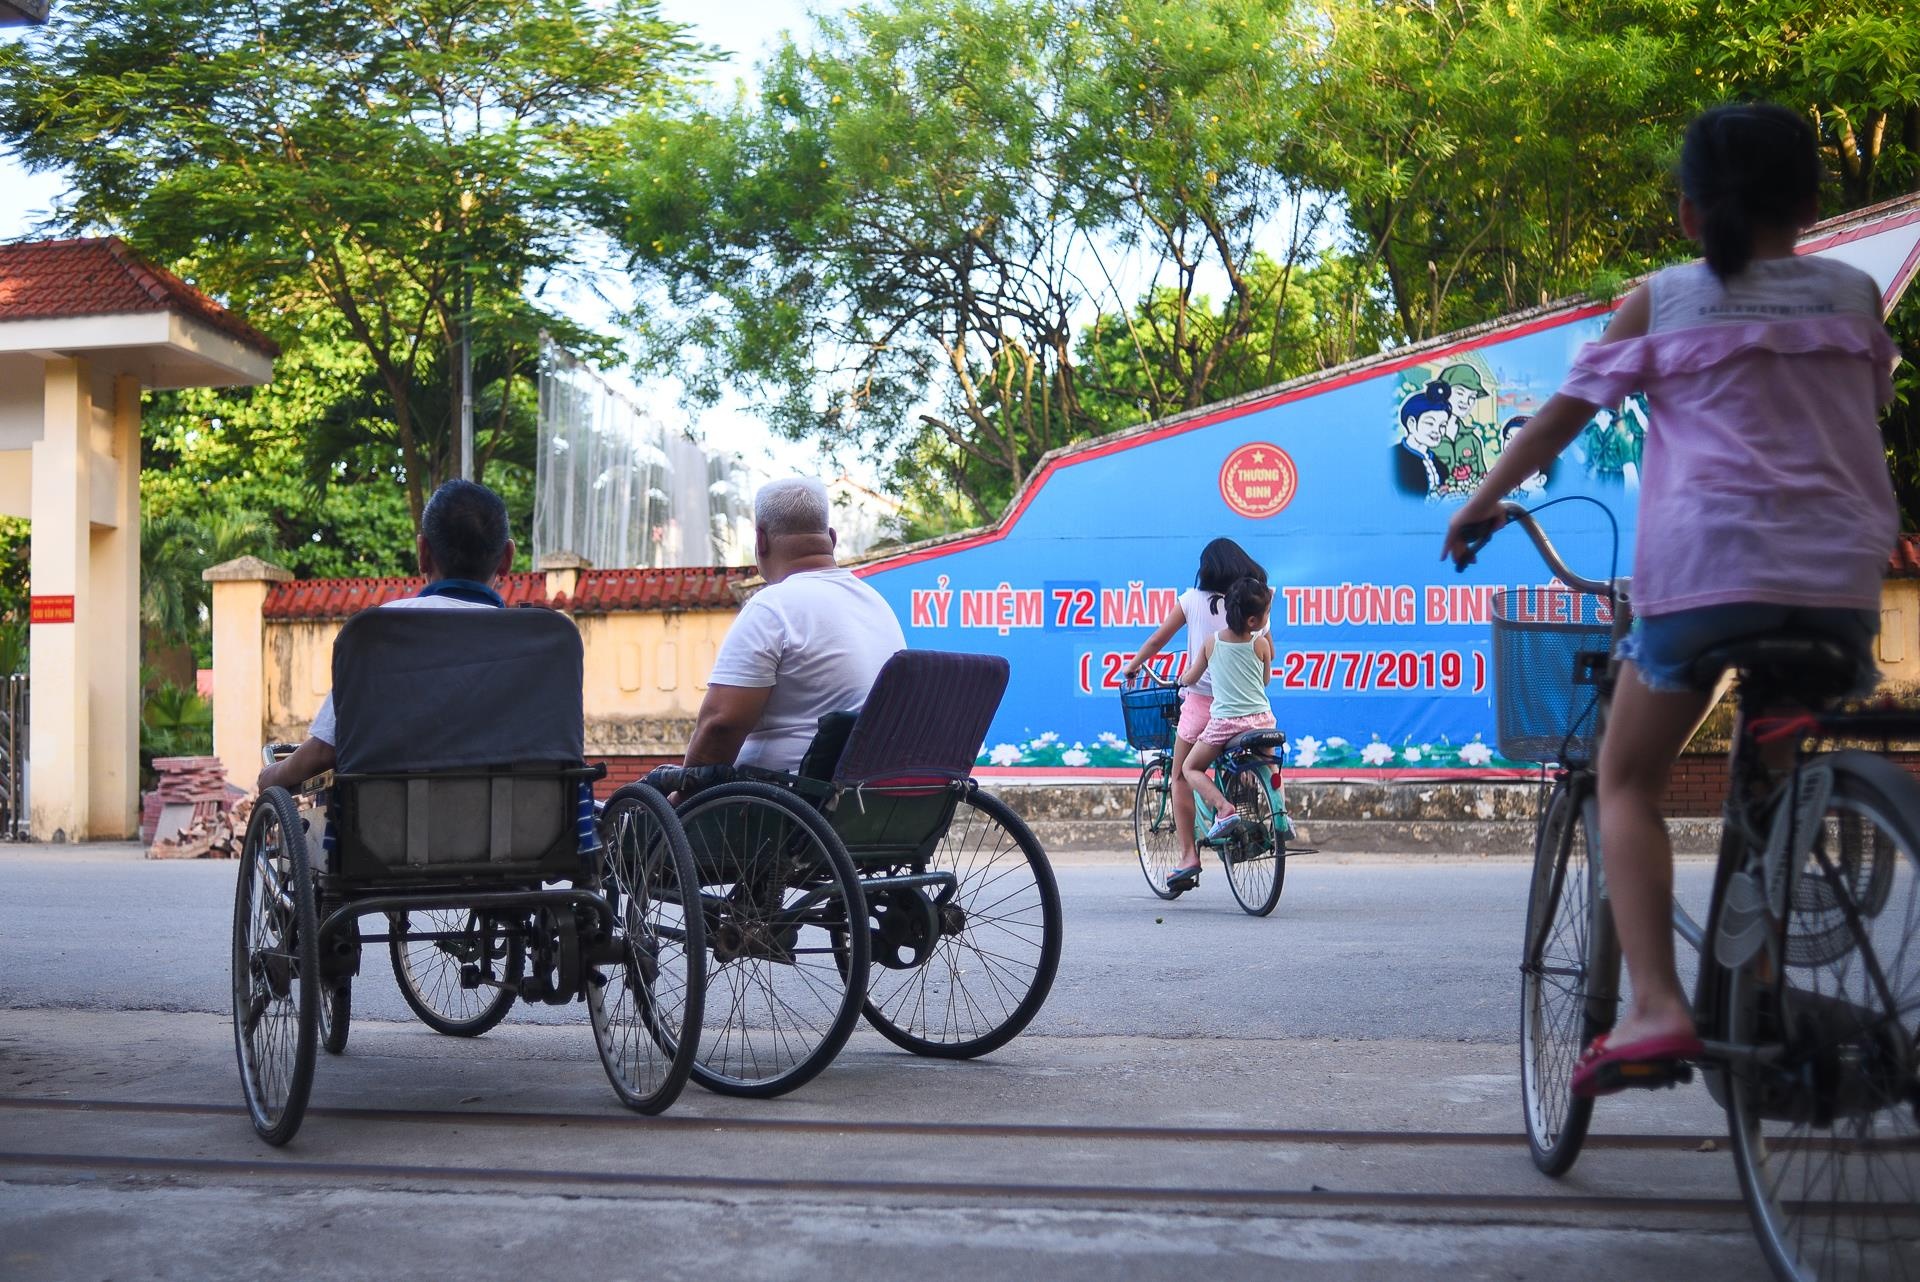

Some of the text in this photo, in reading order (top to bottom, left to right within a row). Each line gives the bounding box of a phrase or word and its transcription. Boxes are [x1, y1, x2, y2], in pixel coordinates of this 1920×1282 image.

[1245, 486, 1271, 498] BINH
[911, 576, 951, 627] KỶ
[961, 583, 1044, 635] NIỆM
[1053, 590, 1095, 626] 72
[1102, 582, 1177, 627] NĂM
[1284, 583, 1415, 625] THƯƠNG
[1425, 586, 1506, 625] BINH
